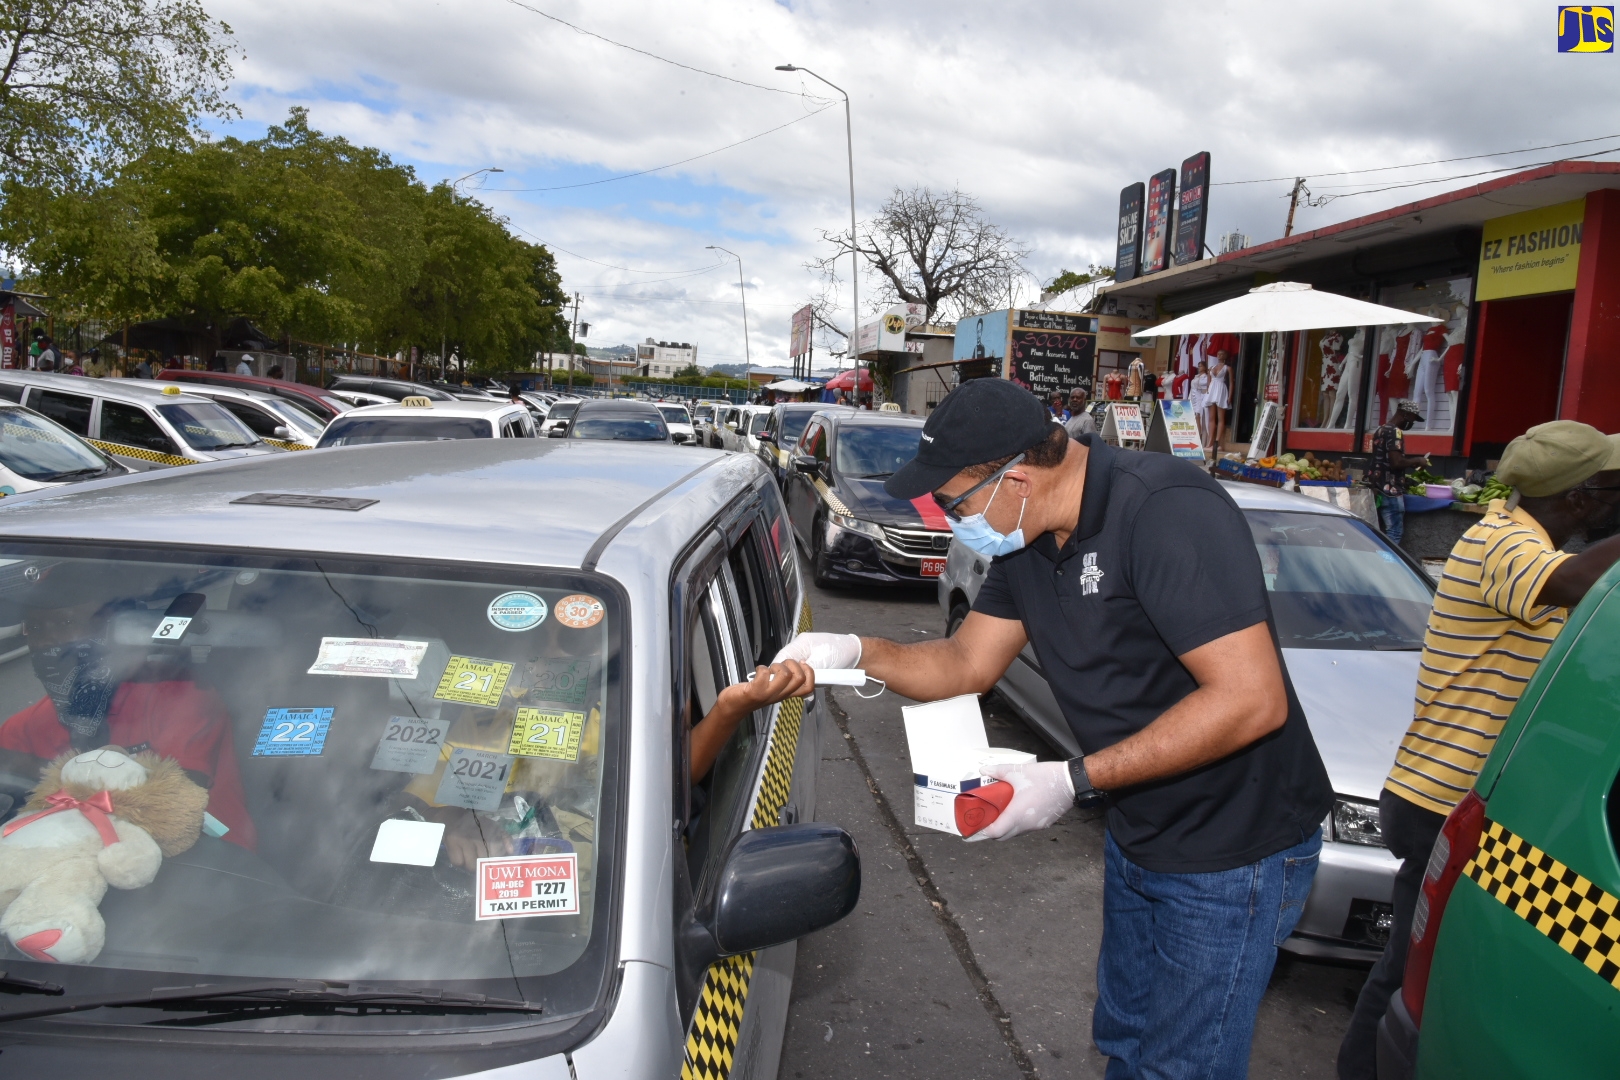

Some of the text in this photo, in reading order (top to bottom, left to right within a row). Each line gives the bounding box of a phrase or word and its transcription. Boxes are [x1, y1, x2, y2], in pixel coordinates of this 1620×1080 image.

[1483, 222, 1583, 260] EZ FASHION
[1514, 260, 1540, 271] fashion
[1022, 362, 1044, 371] Chargers
[1063, 375, 1077, 384] Head
[1078, 376, 1091, 385] Sets
[1115, 406, 1138, 416] TATTOO
[923, 562, 934, 572] PG
[570, 606, 588, 618] 30
[159, 624, 174, 636] 8
[460, 663, 497, 673] JAMAICA
[454, 671, 493, 692] 21
[534, 671, 574, 690] 20
[529, 714, 569, 724] JAMAICA
[271, 722, 315, 742] 22
[386, 724, 441, 744] 2022
[527, 723, 566, 746] 21
[455, 758, 507, 781] 2021
[934, 780, 957, 790] EASIMASK
[488, 866, 567, 880] UWI MONA
[492, 880, 524, 890] JAN-DEC
[536, 882, 566, 895] T277
[498, 890, 519, 898] 2019
[490, 899, 568, 911] TAXI PERMIT
